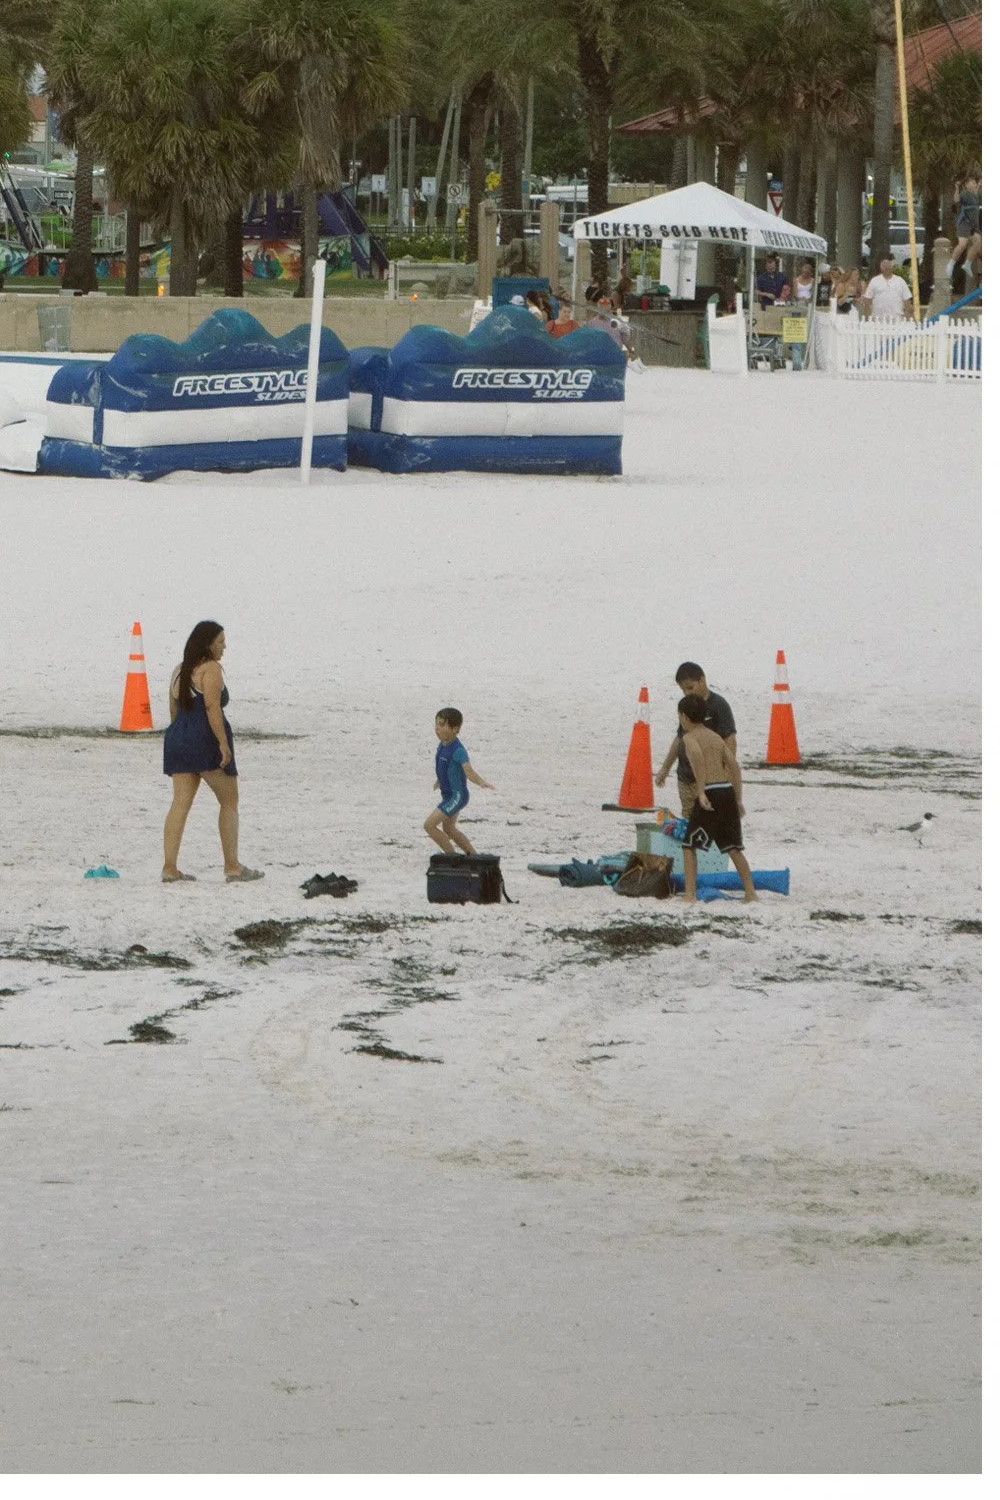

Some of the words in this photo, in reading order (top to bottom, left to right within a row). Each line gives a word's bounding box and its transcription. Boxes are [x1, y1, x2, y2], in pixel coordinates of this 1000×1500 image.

[583, 221, 652, 237] TICKETS
[660, 225, 702, 238] SOLD
[711, 226, 749, 241] HERE
[173, 370, 309, 396] FREESTYLE
[452, 368, 593, 389] FREESTYLE
[255, 391, 307, 401] SLIDES
[532, 389, 586, 399] SLIDES
